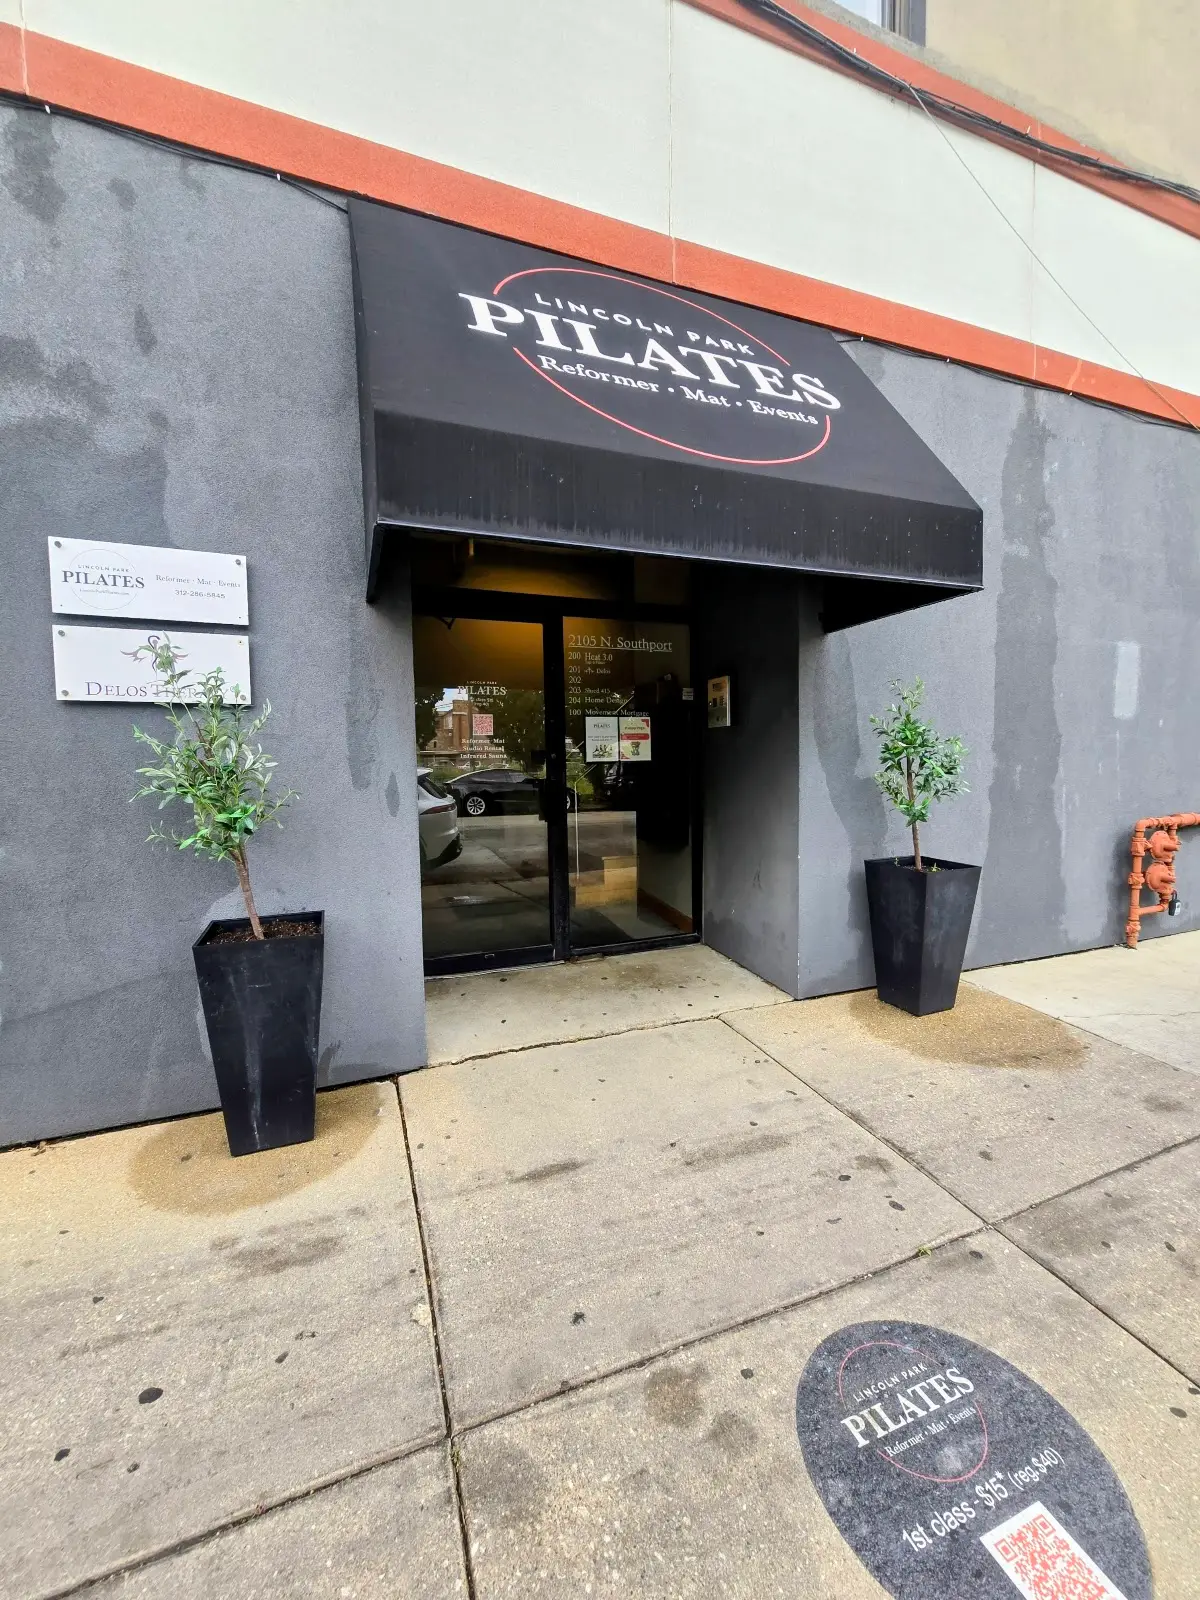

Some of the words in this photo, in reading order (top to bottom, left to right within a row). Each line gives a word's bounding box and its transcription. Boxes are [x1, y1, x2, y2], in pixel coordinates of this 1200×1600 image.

[534, 292, 674, 337] LINCOLN
[686, 330, 755, 357] PARK
[457, 291, 842, 411] PILATES
[536, 354, 660, 393] Reformer
[681, 384, 732, 408] Mat
[747, 398, 819, 425] Events
[62, 570, 145, 589] PILATES
[77, 564, 110, 572] LINCOLN
[156, 574, 190, 584] Reformer
[197, 578, 212, 586] Mat
[218, 580, 242, 588] Events
[568, 634, 597, 647] 2105
[600, 636, 614, 648] N.
[616, 636, 673, 652] Southport
[568, 652, 581, 660] 200
[602, 654, 613, 662] 3.0
[86, 682, 147, 697] DELOS
[457, 685, 507, 696] PILATES
[852, 1373, 901, 1403] LINCOLN
[901, 1361, 928, 1382] PARK
[840, 1366, 976, 1449] PILATES
[884, 1430, 926, 1459] Reformer
[926, 1419, 948, 1436] Mat
[948, 1405, 977, 1426] Events
[902, 1523, 933, 1552] 1st
[930, 1501, 977, 1538] class
